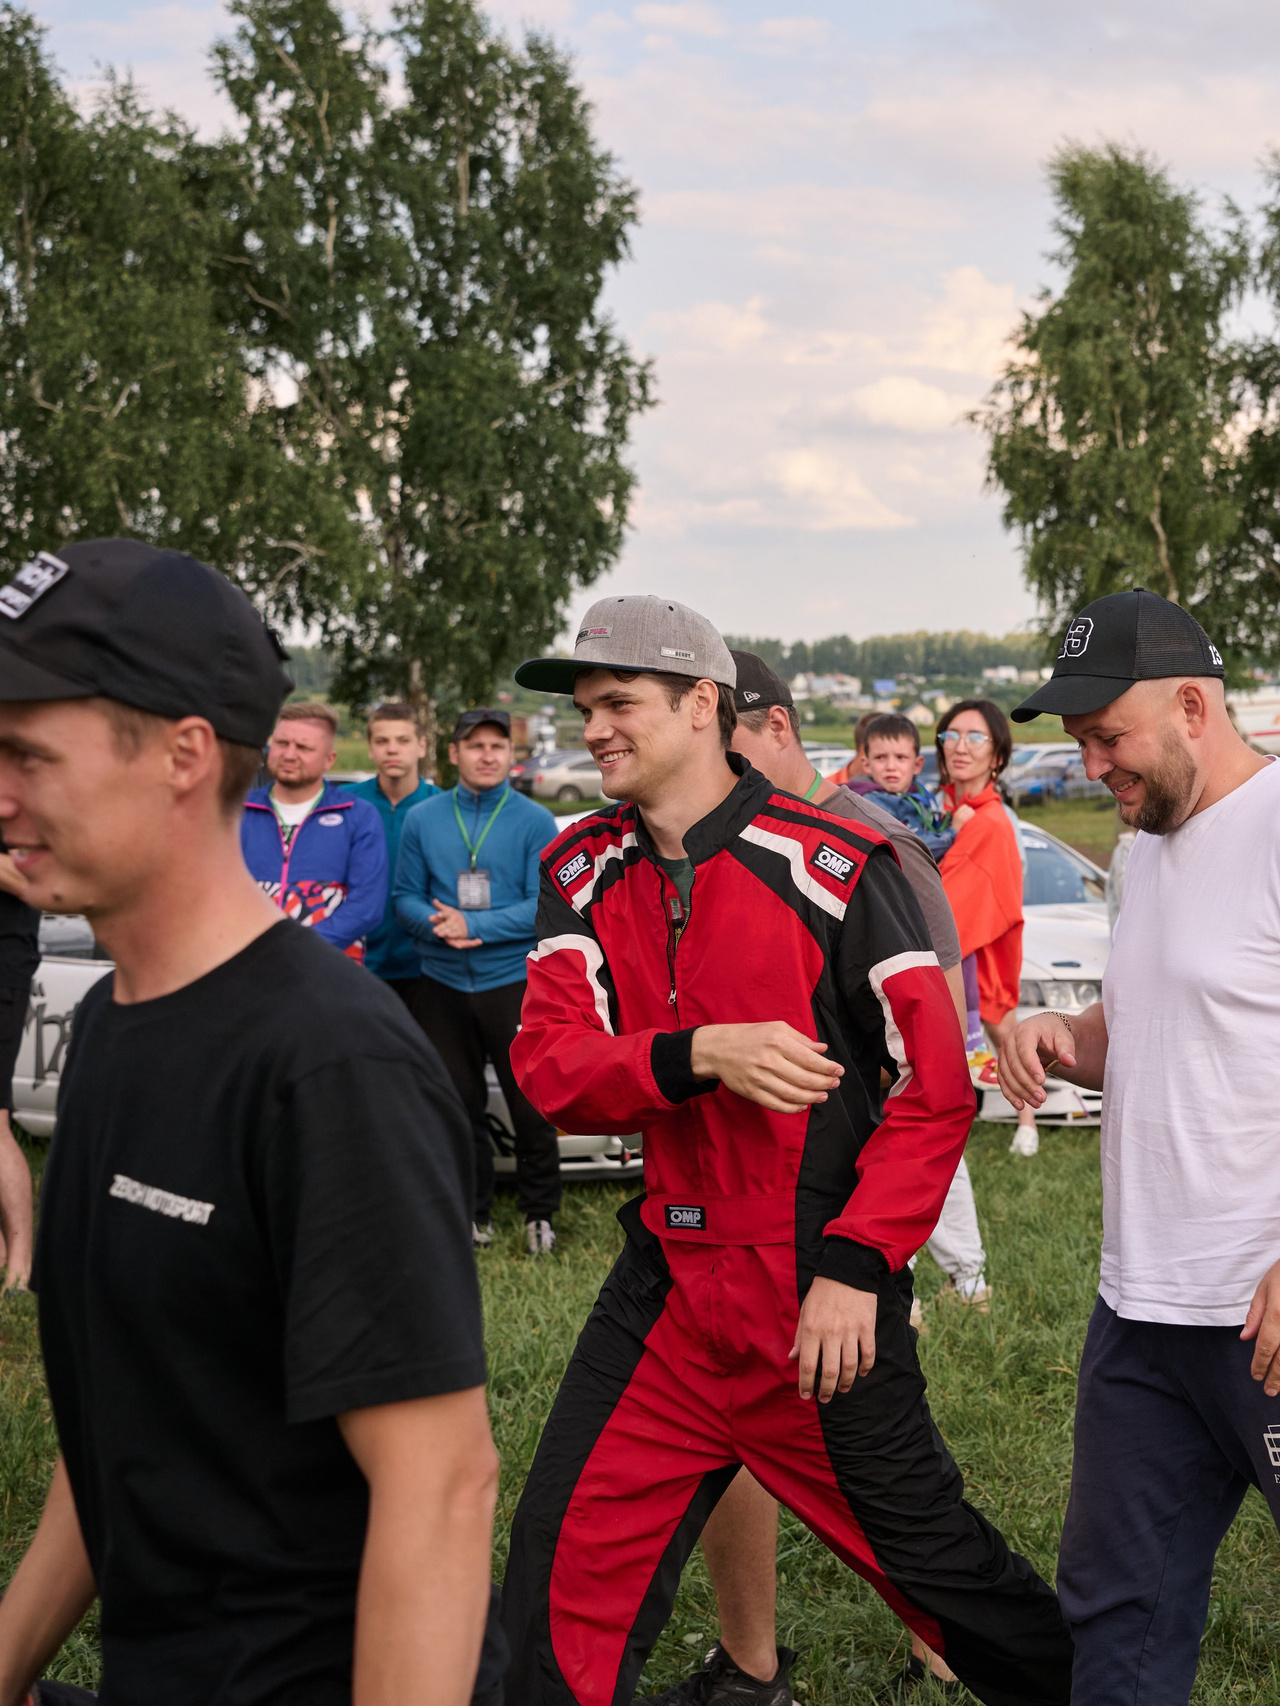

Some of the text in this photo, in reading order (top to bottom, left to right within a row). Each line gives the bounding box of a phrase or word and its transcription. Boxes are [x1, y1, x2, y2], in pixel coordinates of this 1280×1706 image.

[588, 627, 608, 636] FUEL
[559, 855, 587, 882] OMP
[818, 851, 851, 875] OMP
[670, 1210, 701, 1224] OMP
